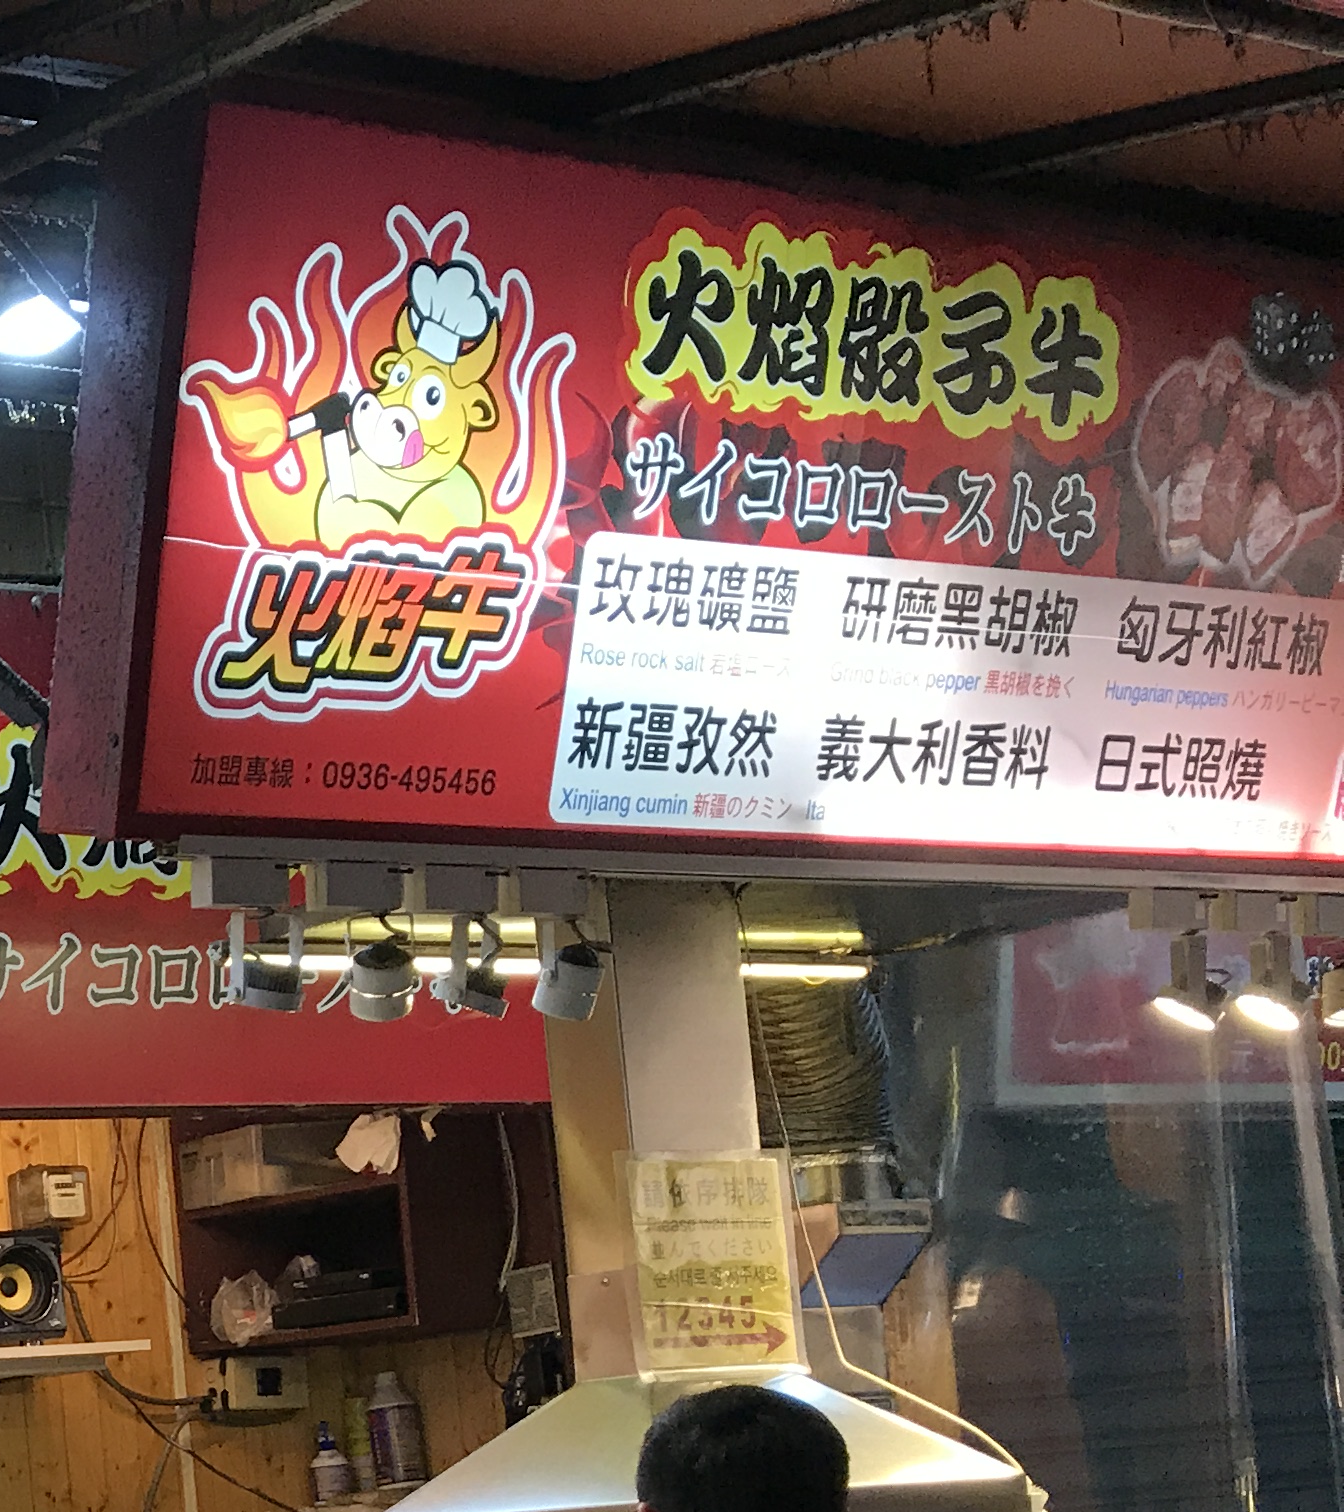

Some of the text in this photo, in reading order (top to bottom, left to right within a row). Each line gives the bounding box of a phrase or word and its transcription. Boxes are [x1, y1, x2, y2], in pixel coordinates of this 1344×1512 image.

[643, 249, 1107, 427] 火焰骰子牛
[626, 434, 1098, 558] サイコロロースト牛
[220, 544, 524, 692] 火焰牛
[590, 552, 1330, 677] 玫瑰礦鹽 研磨黑胡椒 匈牙利紅椒
[580, 642, 705, 673] Rose rock salt
[925, 673, 981, 695] pepper
[1105, 679, 1173, 707] Hungarian
[1176, 687, 1229, 709] peppers
[568, 696, 778, 778] 新疆孜然
[816, 713, 1052, 790] 義大利香料
[1095, 732, 1267, 802] 日式照燒
[322, 760, 497, 796] 0936-495456
[560, 788, 632, 817] Xinjiang
[636, 793, 687, 815] cumin
[647, 1217, 696, 1232] Please
